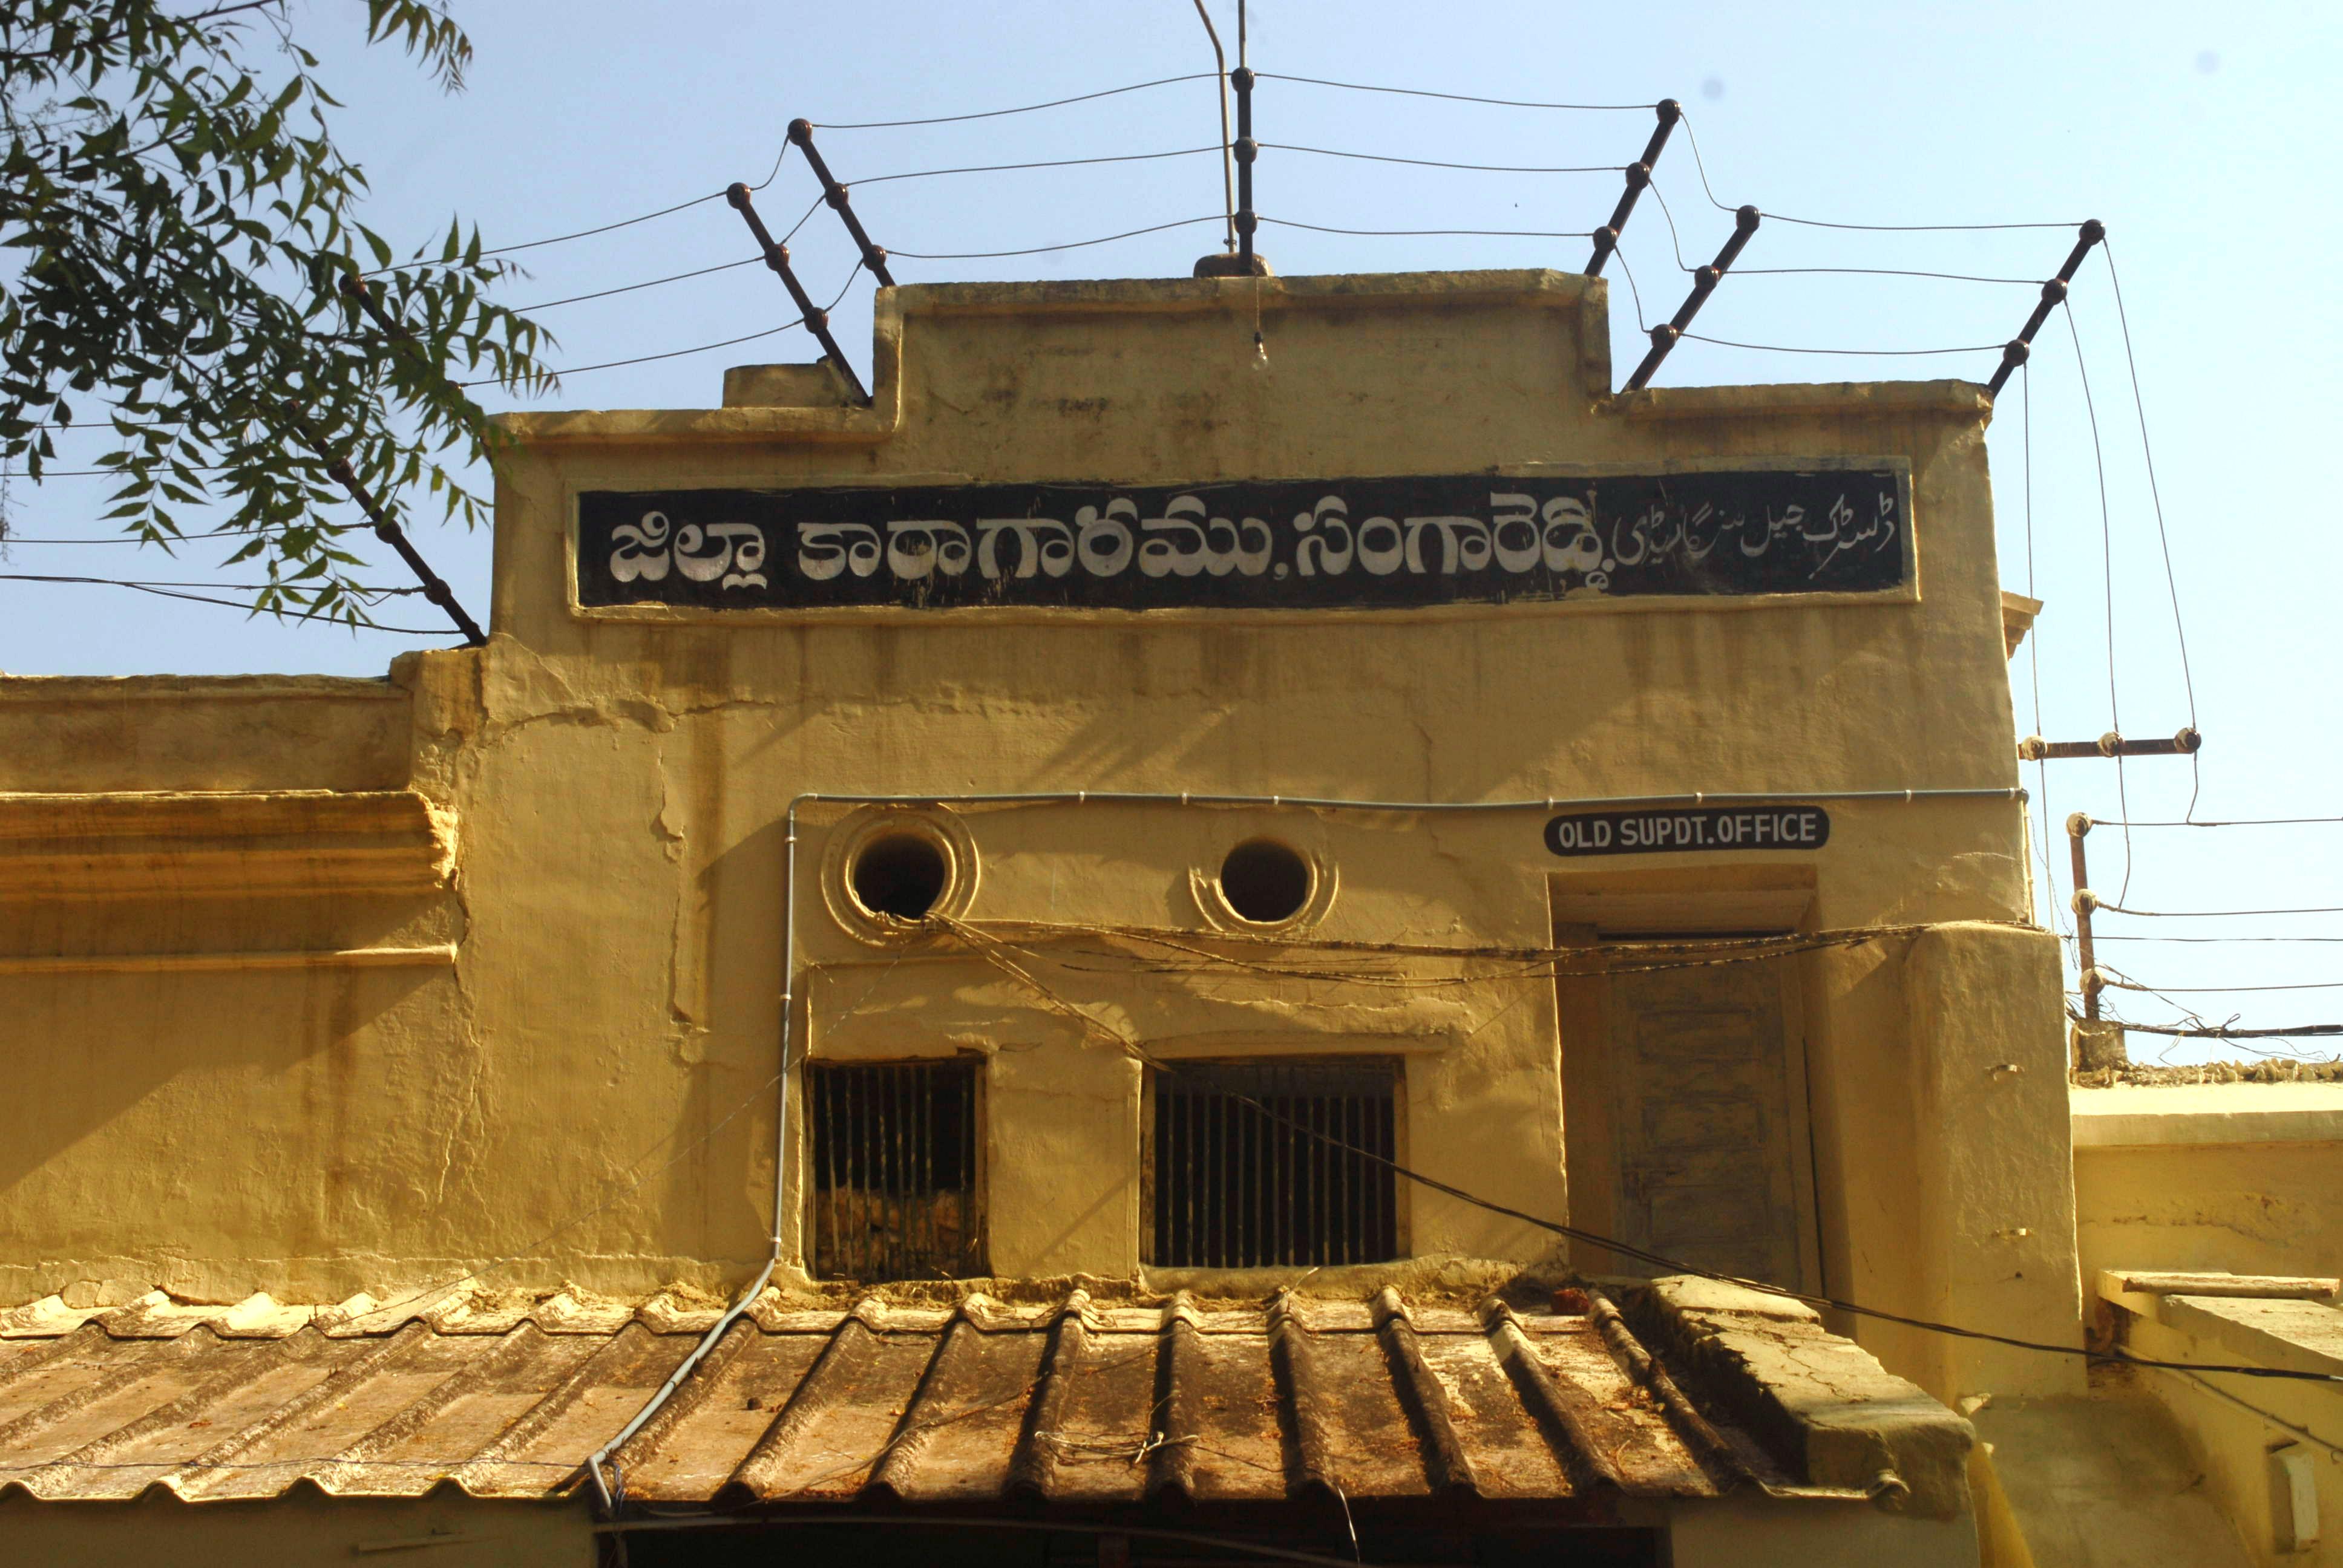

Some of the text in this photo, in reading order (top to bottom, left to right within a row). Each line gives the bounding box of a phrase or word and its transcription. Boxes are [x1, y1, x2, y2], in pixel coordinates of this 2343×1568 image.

[609, 511, 767, 590] జిల్లా
[1740, 505, 1806, 557] جیل
[1559, 821, 1611, 849] OLD
